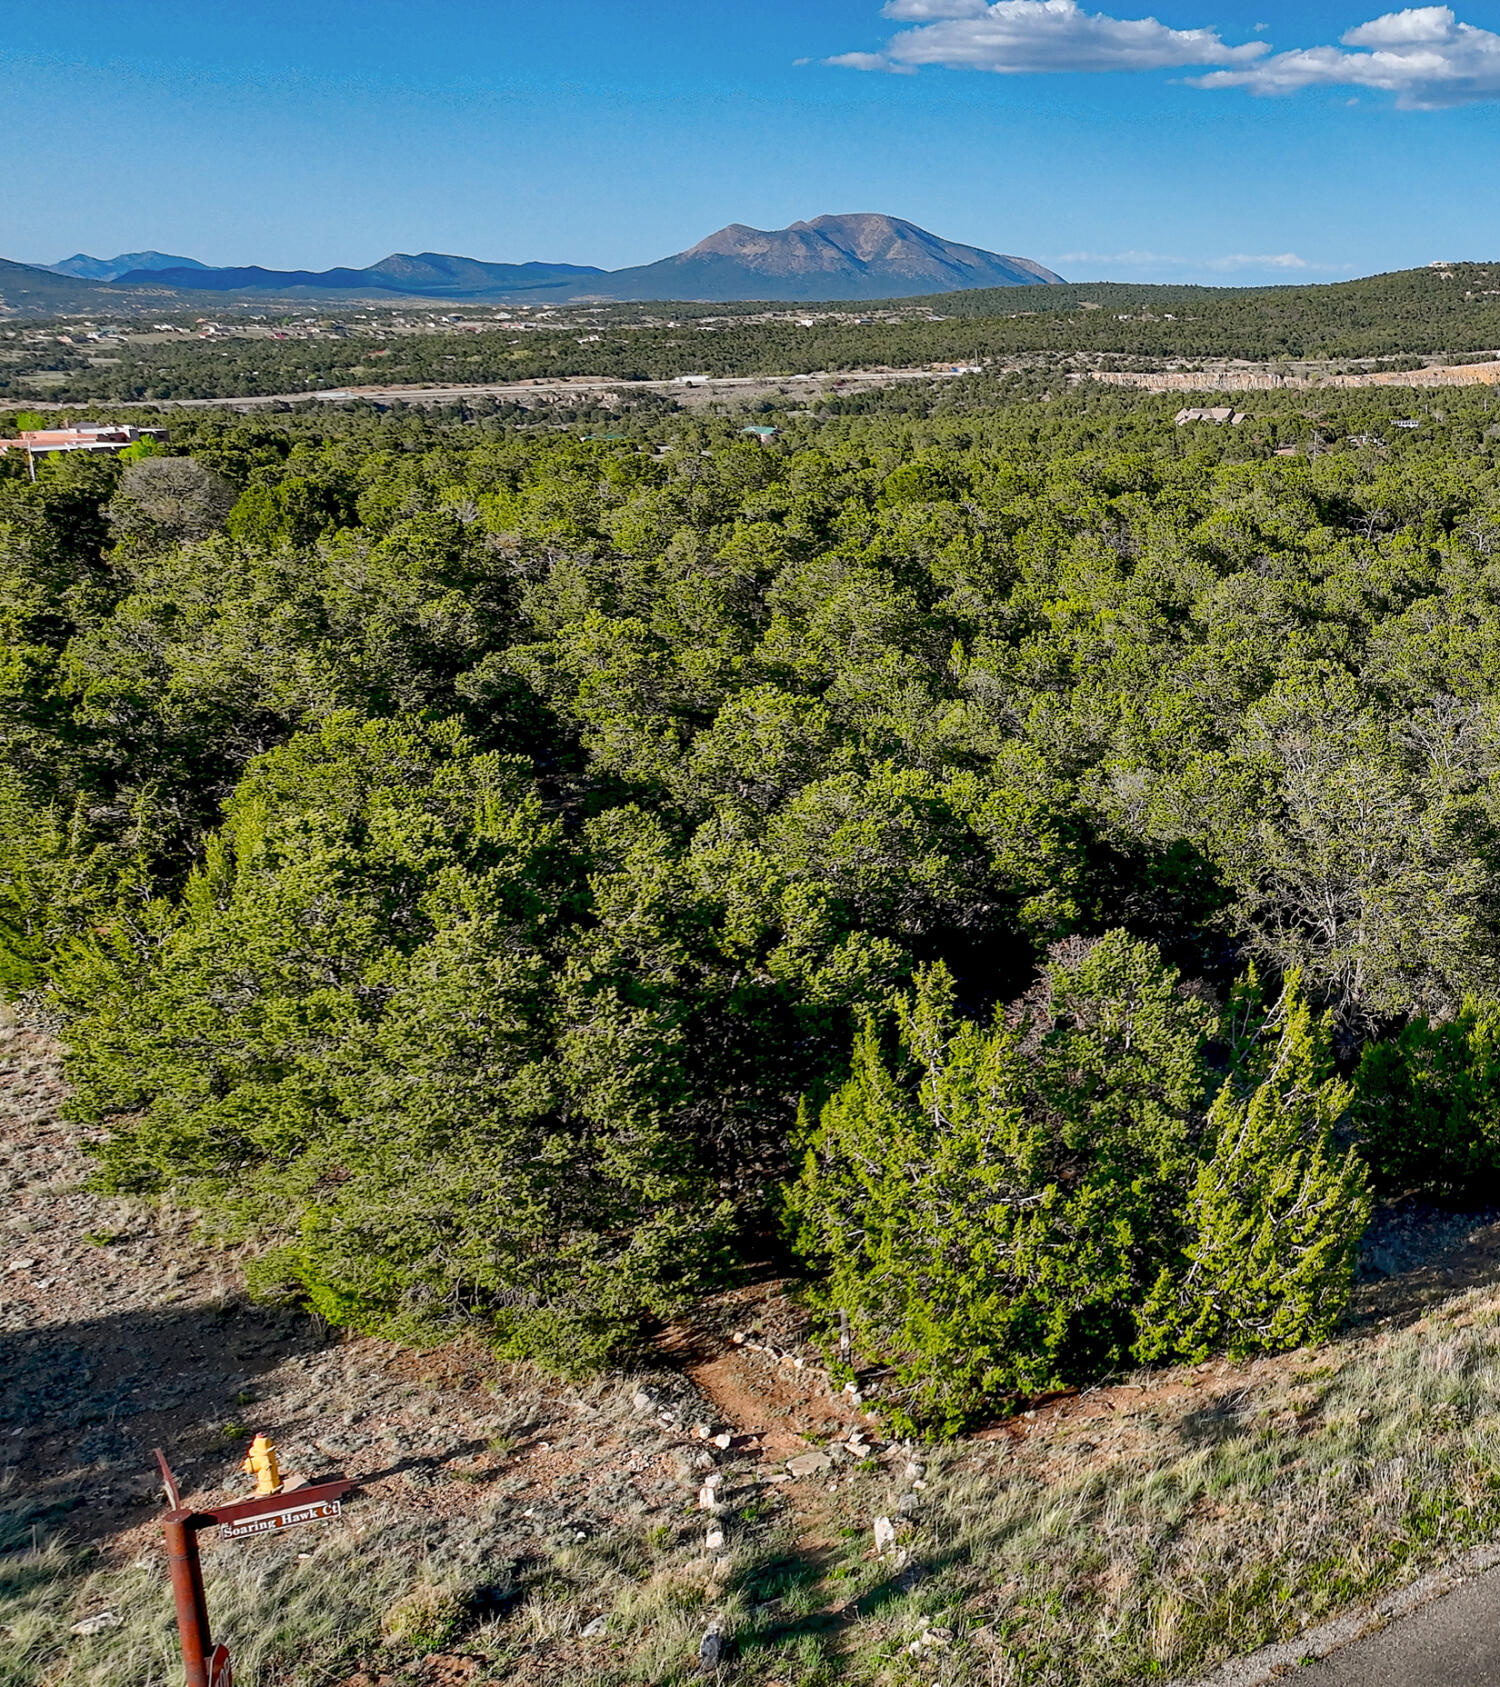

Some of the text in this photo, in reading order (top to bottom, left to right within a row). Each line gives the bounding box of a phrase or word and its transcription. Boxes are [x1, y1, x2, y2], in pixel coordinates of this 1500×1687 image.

[223, 1504, 338, 1538] Soaring Hawk Ct
